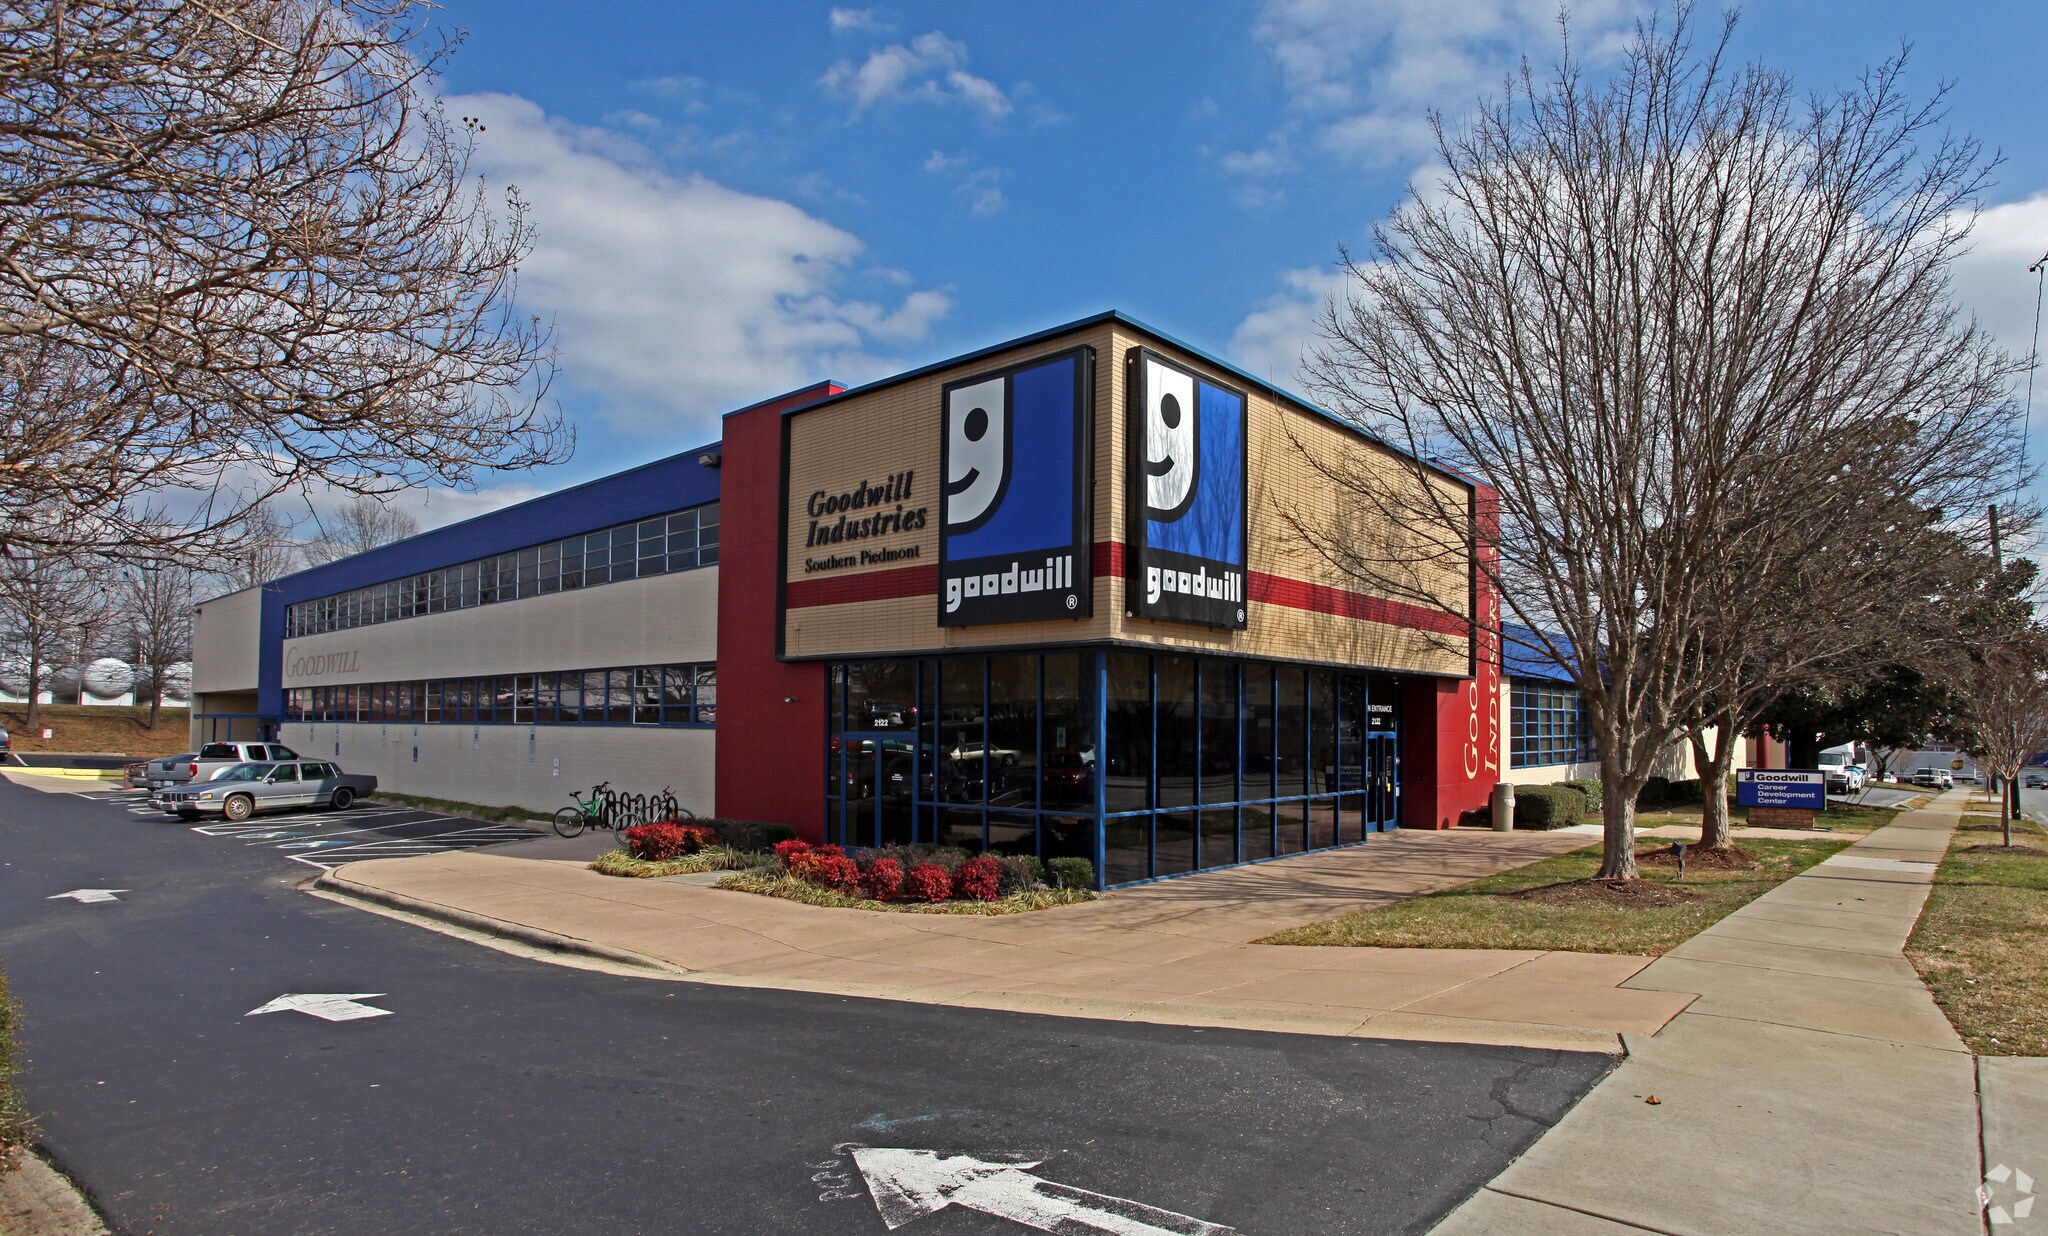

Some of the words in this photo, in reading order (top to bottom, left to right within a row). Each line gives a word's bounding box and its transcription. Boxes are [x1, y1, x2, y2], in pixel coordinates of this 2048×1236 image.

[807, 470, 914, 517] Goodwill
[805, 504, 927, 547] Industries
[804, 555, 856, 573] Southern
[860, 545, 920, 565] Piedmont
[946, 555, 1072, 613] goodwill
[1147, 566, 1241, 604] goodwill
[285, 647, 360, 678] GOODWILL
[874, 719, 889, 727] 2122
[1371, 705, 1393, 713] ENTRANCE
[1756, 774, 1809, 782] Goodwill
[1757, 791, 1815, 799] Development
